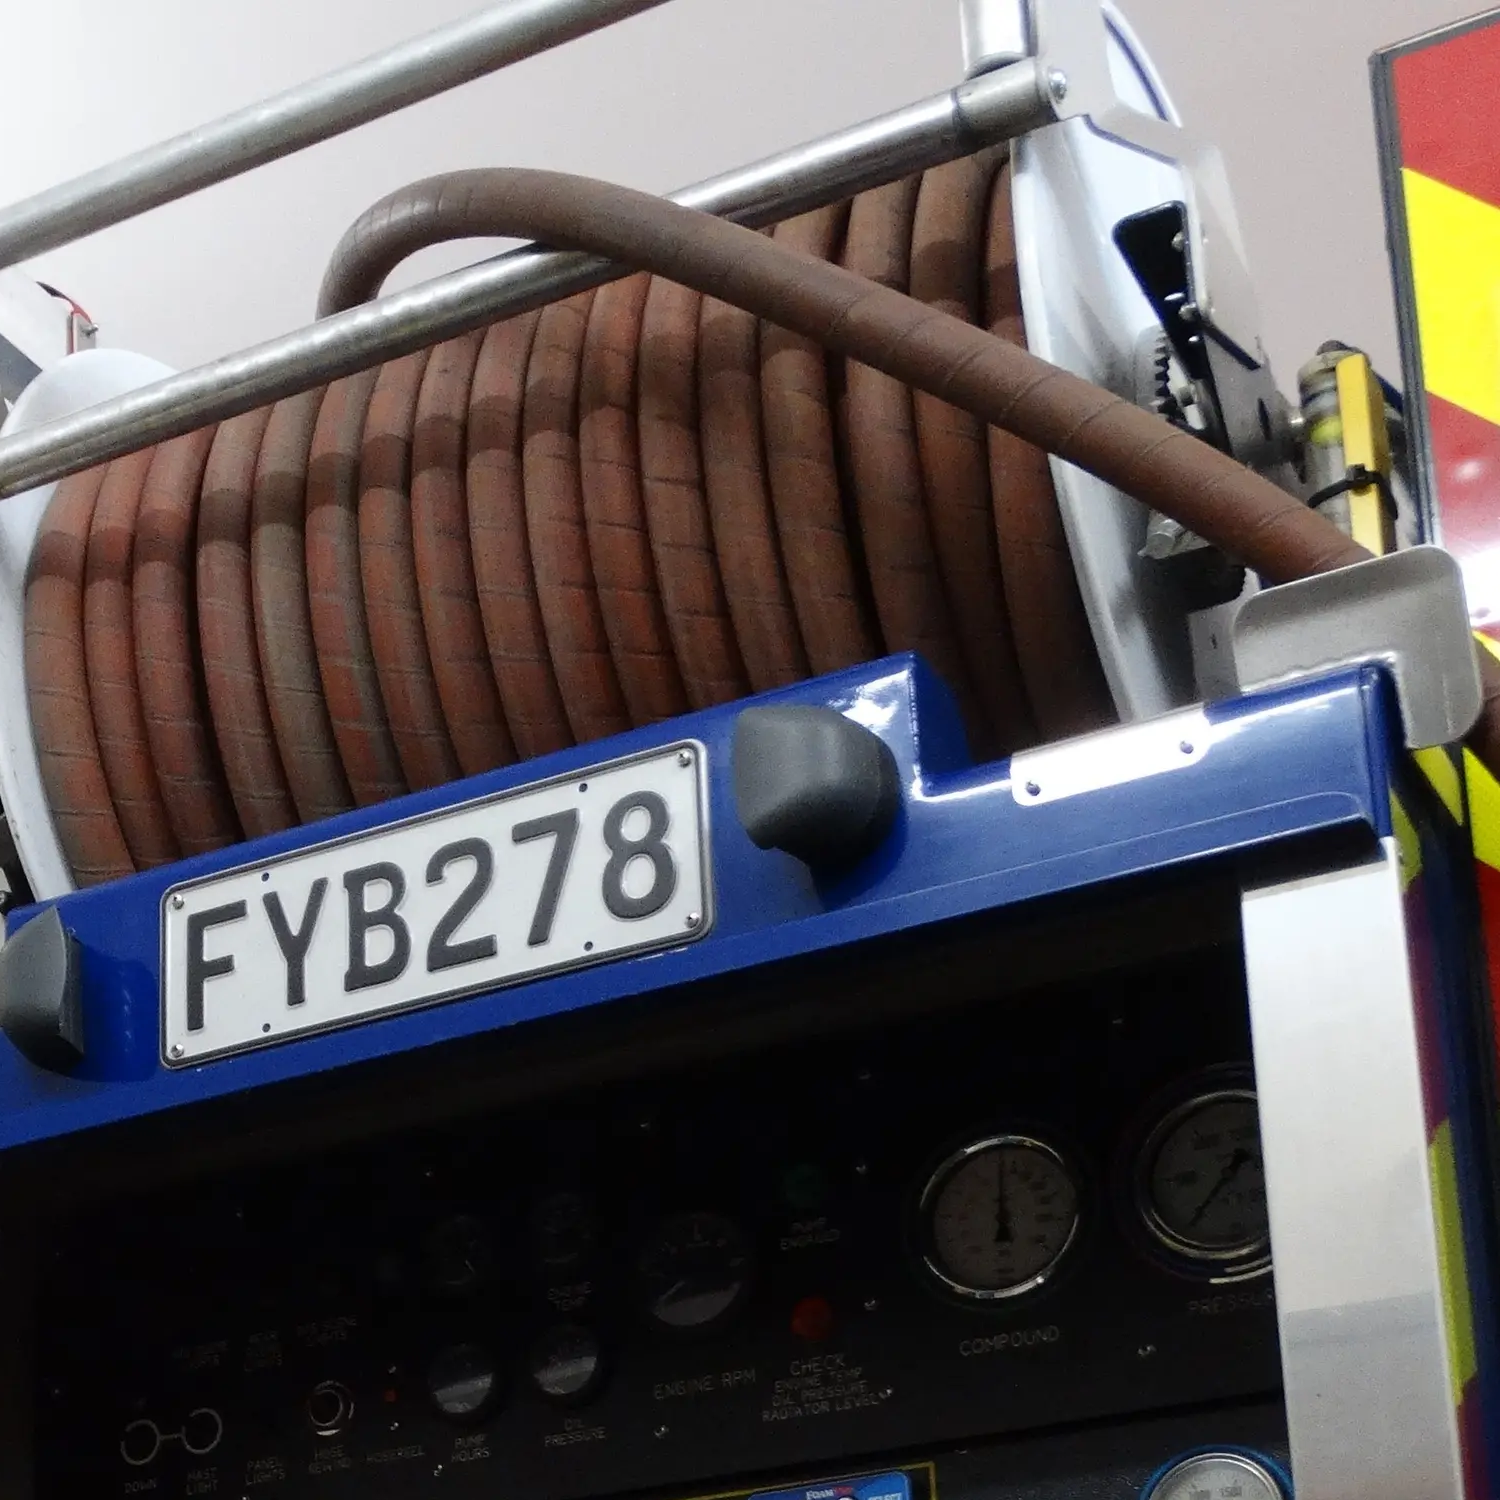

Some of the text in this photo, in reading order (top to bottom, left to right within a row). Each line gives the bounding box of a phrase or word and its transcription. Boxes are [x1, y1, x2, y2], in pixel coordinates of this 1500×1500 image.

[186, 790, 678, 1031] FYB278
[1187, 1287, 1273, 1316] PRESSUR
[959, 1325, 1060, 1357] COMPOUND
[790, 1353, 846, 1376] CHECK
[653, 1368, 757, 1400] ENGINE RPM
